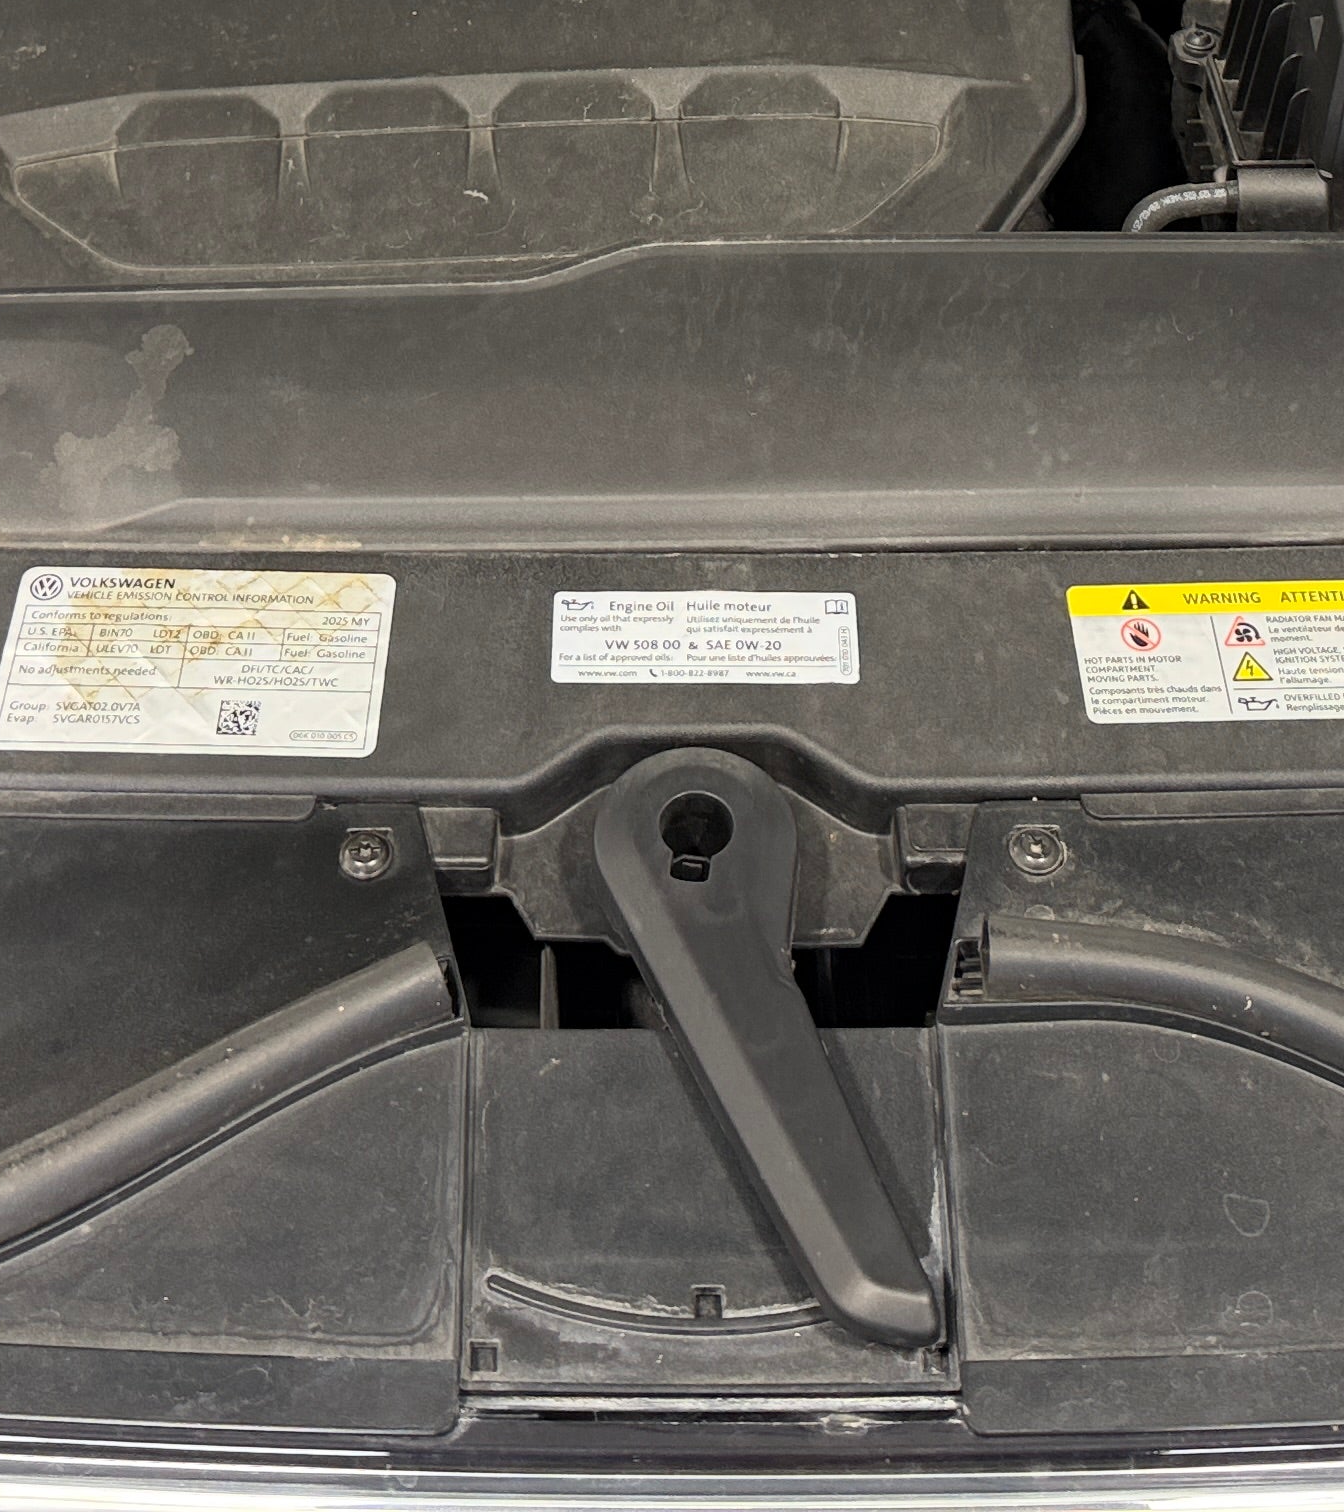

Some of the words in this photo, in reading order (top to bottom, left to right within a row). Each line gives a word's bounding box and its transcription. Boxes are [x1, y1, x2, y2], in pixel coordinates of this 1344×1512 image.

[69, 577, 177, 589] VOLKSWAGEN
[67, 590, 113, 600] VEHICLE
[116, 591, 172, 601] EMISSION
[175, 591, 229, 603] CONTROL
[232, 593, 314, 605] INFORMATION
[1182, 591, 1262, 605] WARNING
[609, 600, 653, 614] Engine
[655, 600, 674, 611] Oil
[686, 599, 720, 611] Huile
[723, 602, 772, 612] moteur
[31, 610, 87, 621] Conforms
[89, 611, 102, 620] to
[578, 615, 598, 624] only
[632, 615, 674, 624] expressly
[686, 615, 720, 624] Utilisez
[721, 615, 778, 625] uniquement
[779, 616, 791, 624] de
[1266, 614, 1312, 623] RADIATOR
[1313, 614, 1332, 622] FAN
[321, 616, 348, 626] 2025
[350, 617, 370, 626] MY
[99, 628, 134, 638] BIN70
[559, 624, 599, 633] complies
[601, 624, 622, 632] with
[686, 625, 701, 634] qui
[703, 625, 739, 633] satisfait
[1268, 626, 1280, 634] Le
[1281, 625, 1332, 633] ventilateur
[227, 630, 244, 641] CA
[318, 632, 368, 644] Gasoline
[23, 641, 79, 652] California
[604, 639, 630, 650] VW
[633, 639, 659, 650] 508
[662, 639, 681, 650] 00
[688, 640, 699, 650] &
[706, 639, 732, 650] SAE
[735, 639, 782, 651] 0W-20
[225, 646, 242, 657] CA
[316, 648, 366, 660] Gasoline
[1273, 647, 1297, 656] HIGH
[558, 652, 574, 661] For
[582, 652, 597, 661] list
[598, 652, 608, 661] of
[610, 653, 653, 663] approved
[686, 653, 707, 662] Pour
[727, 653, 746, 662] liste
[1084, 656, 1103, 665] HOT
[1105, 656, 1134, 664] PARTS
[1136, 656, 1146, 664] IN
[1147, 654, 1182, 664] MOTOR
[1275, 655, 1318, 664] IGNITION
[18, 664, 35, 675] No
[37, 664, 110, 676] adjustments
[112, 665, 158, 676] needed
[1277, 667, 1306, 675] Haute
[1087, 674, 1125, 683] MOVING
[1089, 686, 1145, 696] Composants
[1166, 685, 1198, 694] chauds
[1200, 684, 1223, 693] dans
[1091, 696, 1100, 705] le
[1102, 696, 1170, 706] compartiment
[1284, 693, 1341, 702] OVERFILLED
[1124, 707, 1137, 715] en
